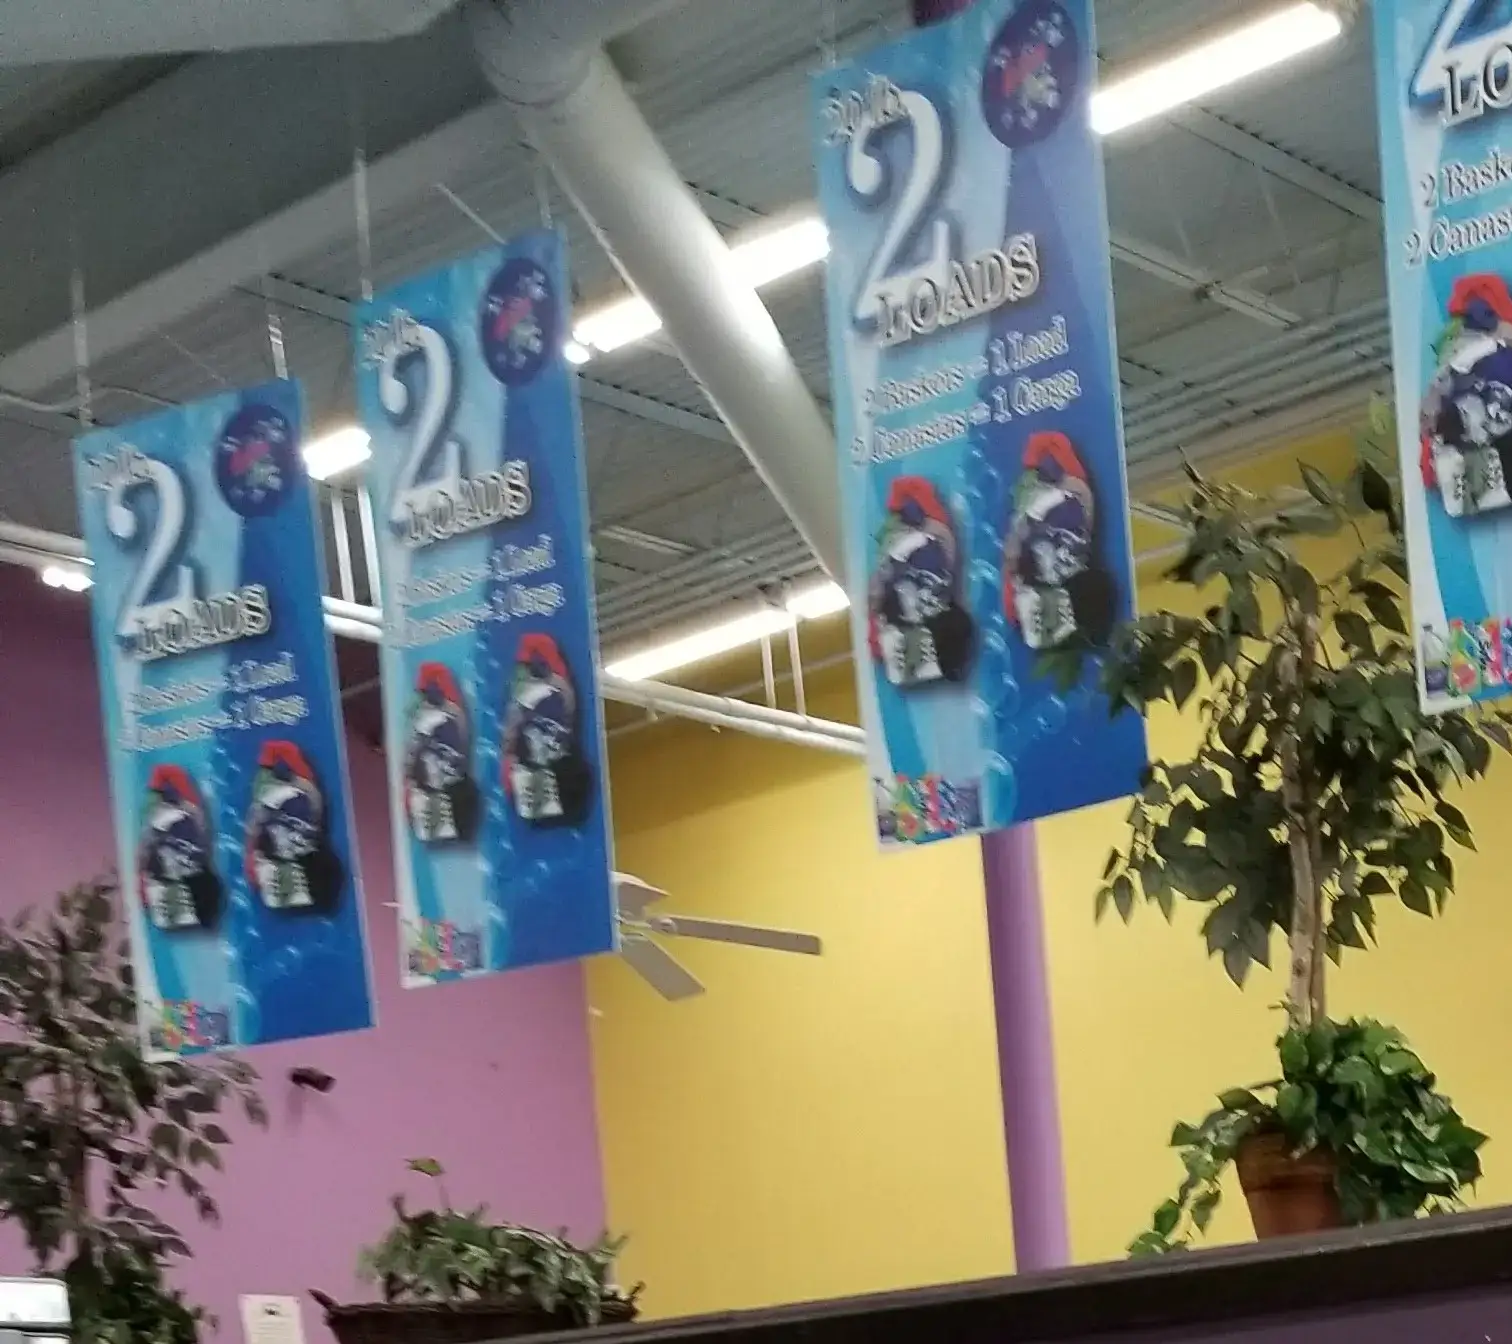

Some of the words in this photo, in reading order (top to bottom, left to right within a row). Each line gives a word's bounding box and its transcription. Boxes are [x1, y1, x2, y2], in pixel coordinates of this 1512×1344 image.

[850, 90, 948, 322] 2
[875, 232, 1039, 348] LOADS
[378, 324, 460, 527] 2
[107, 458, 194, 642] 2
